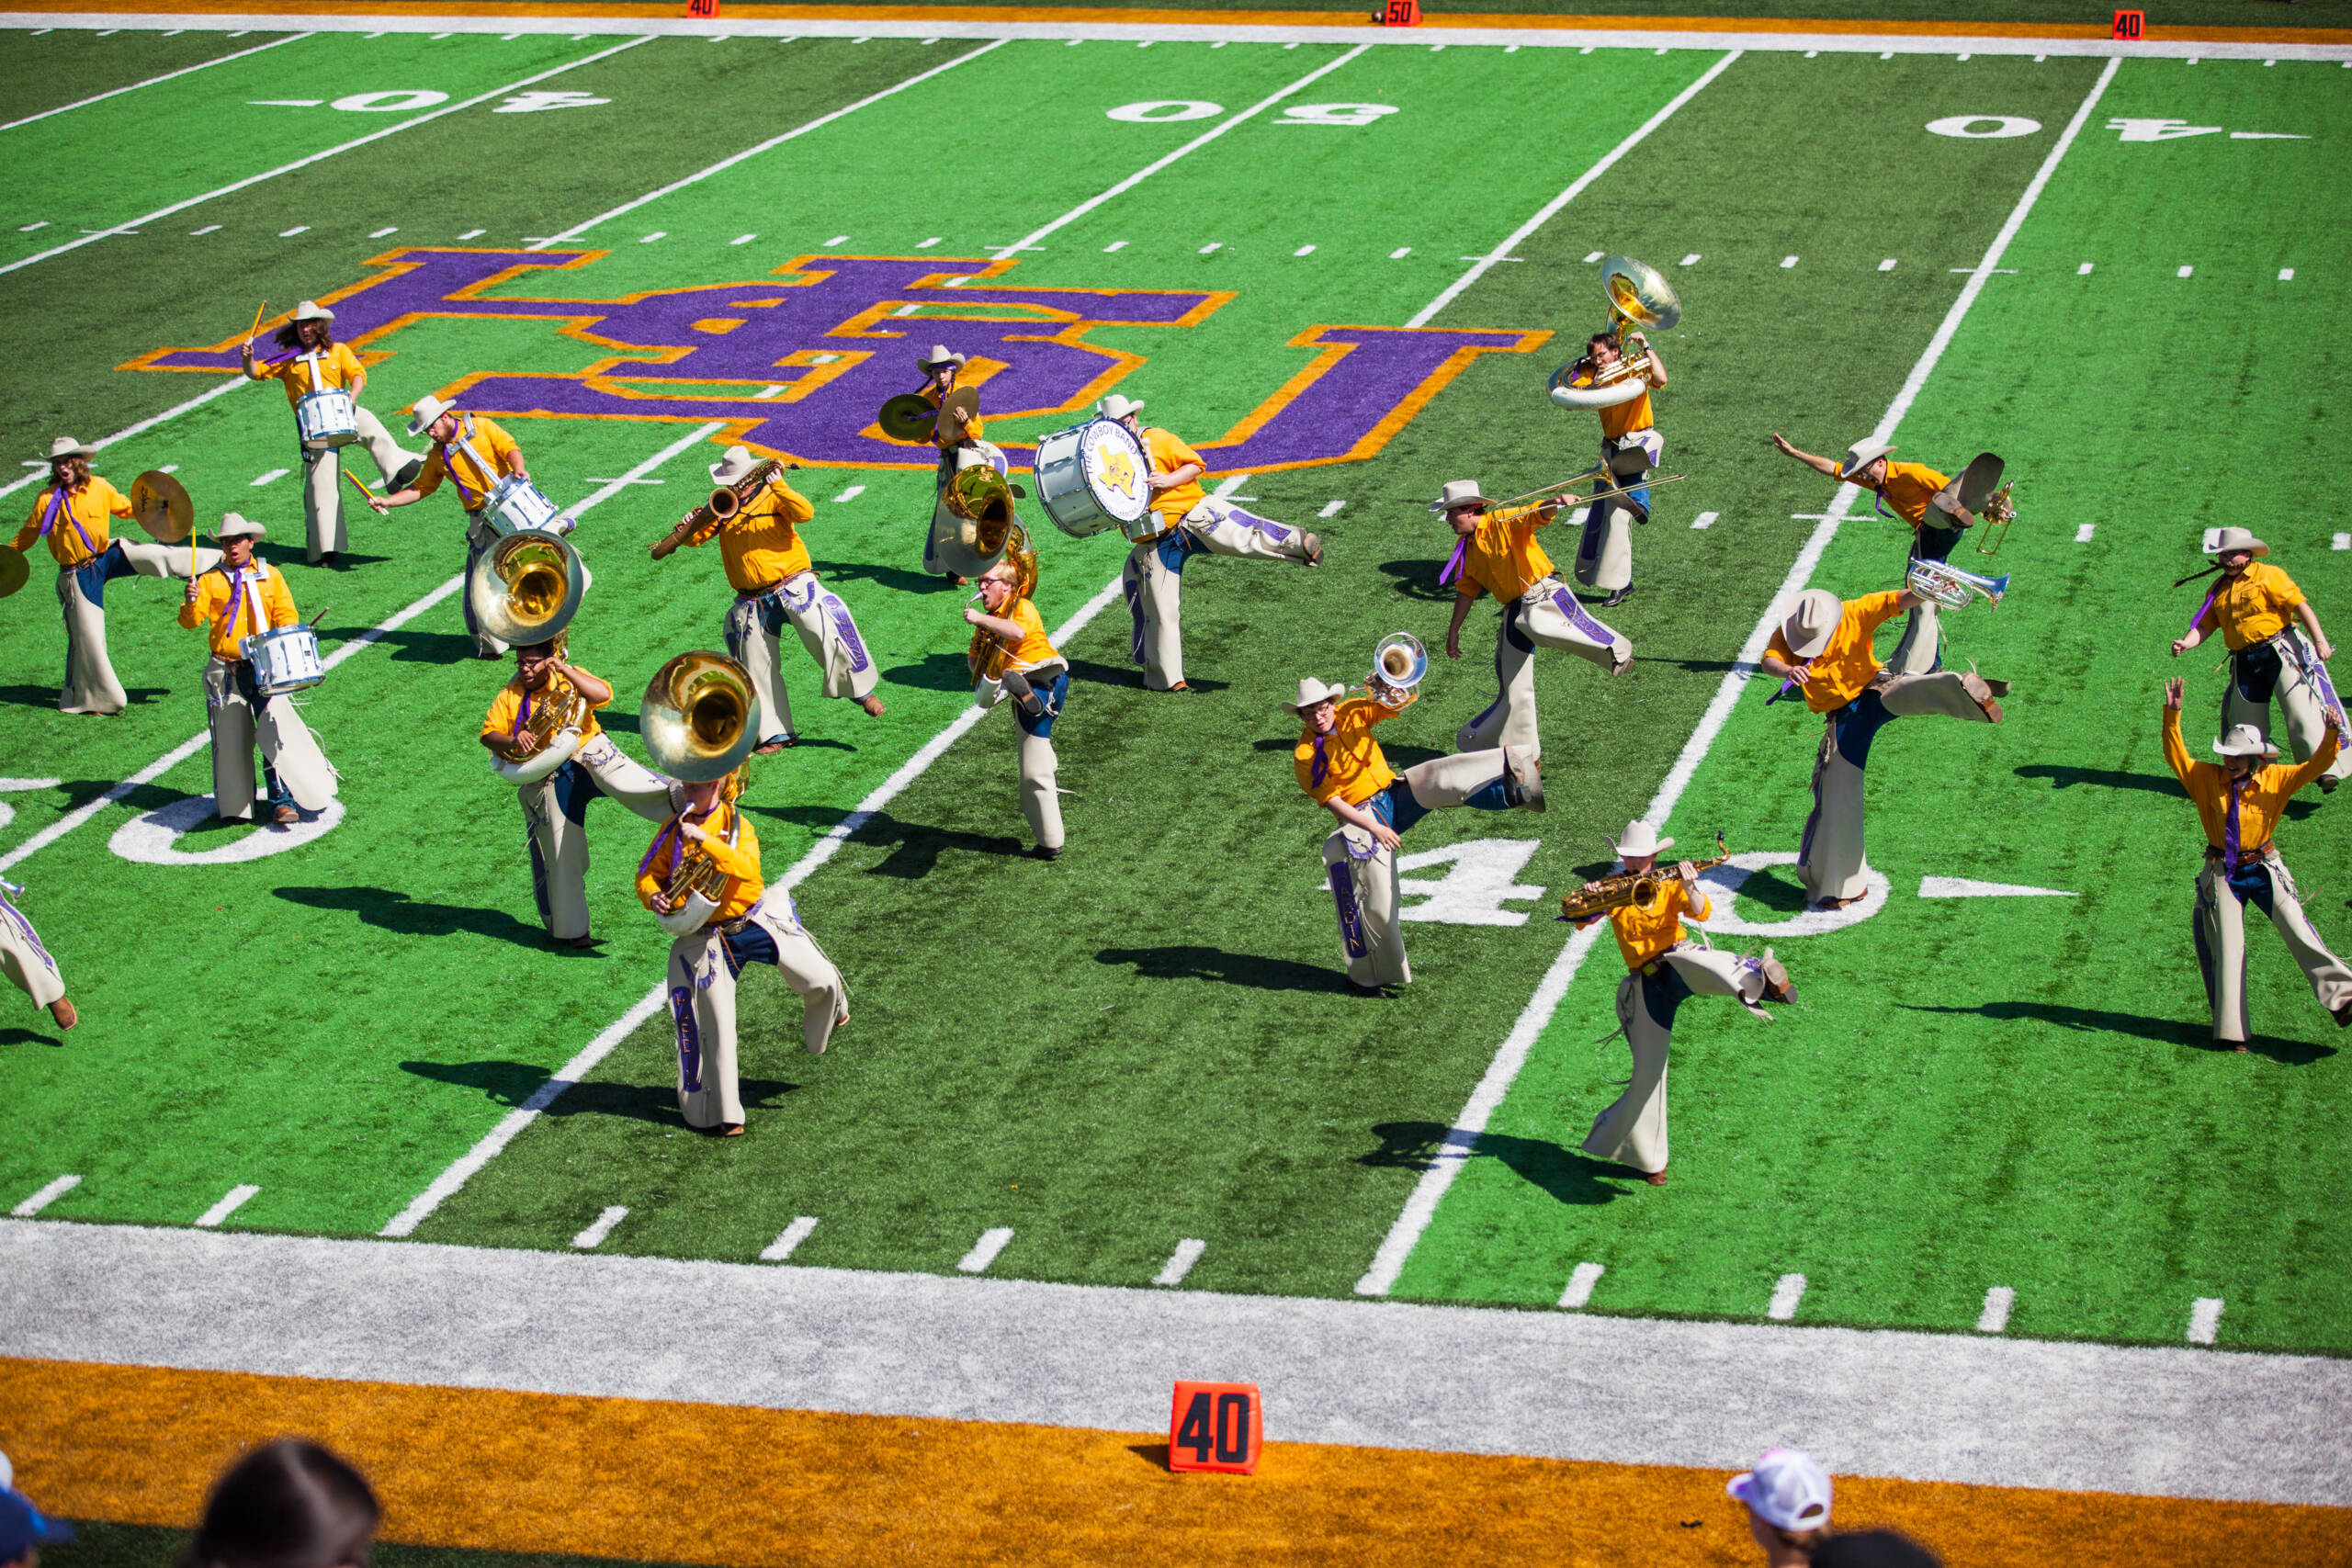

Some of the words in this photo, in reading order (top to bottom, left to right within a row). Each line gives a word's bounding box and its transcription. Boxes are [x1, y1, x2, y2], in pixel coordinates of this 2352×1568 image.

[690, 0, 712, 15] 40
[1388, 1, 1411, 22] 50
[2116, 14, 2141, 37] 40
[1086, 424, 1114, 452] COWBOY
[1114, 426, 1138, 456] BAND
[1085, 453, 1094, 476] THE
[1177, 1393, 1250, 1463] 40
